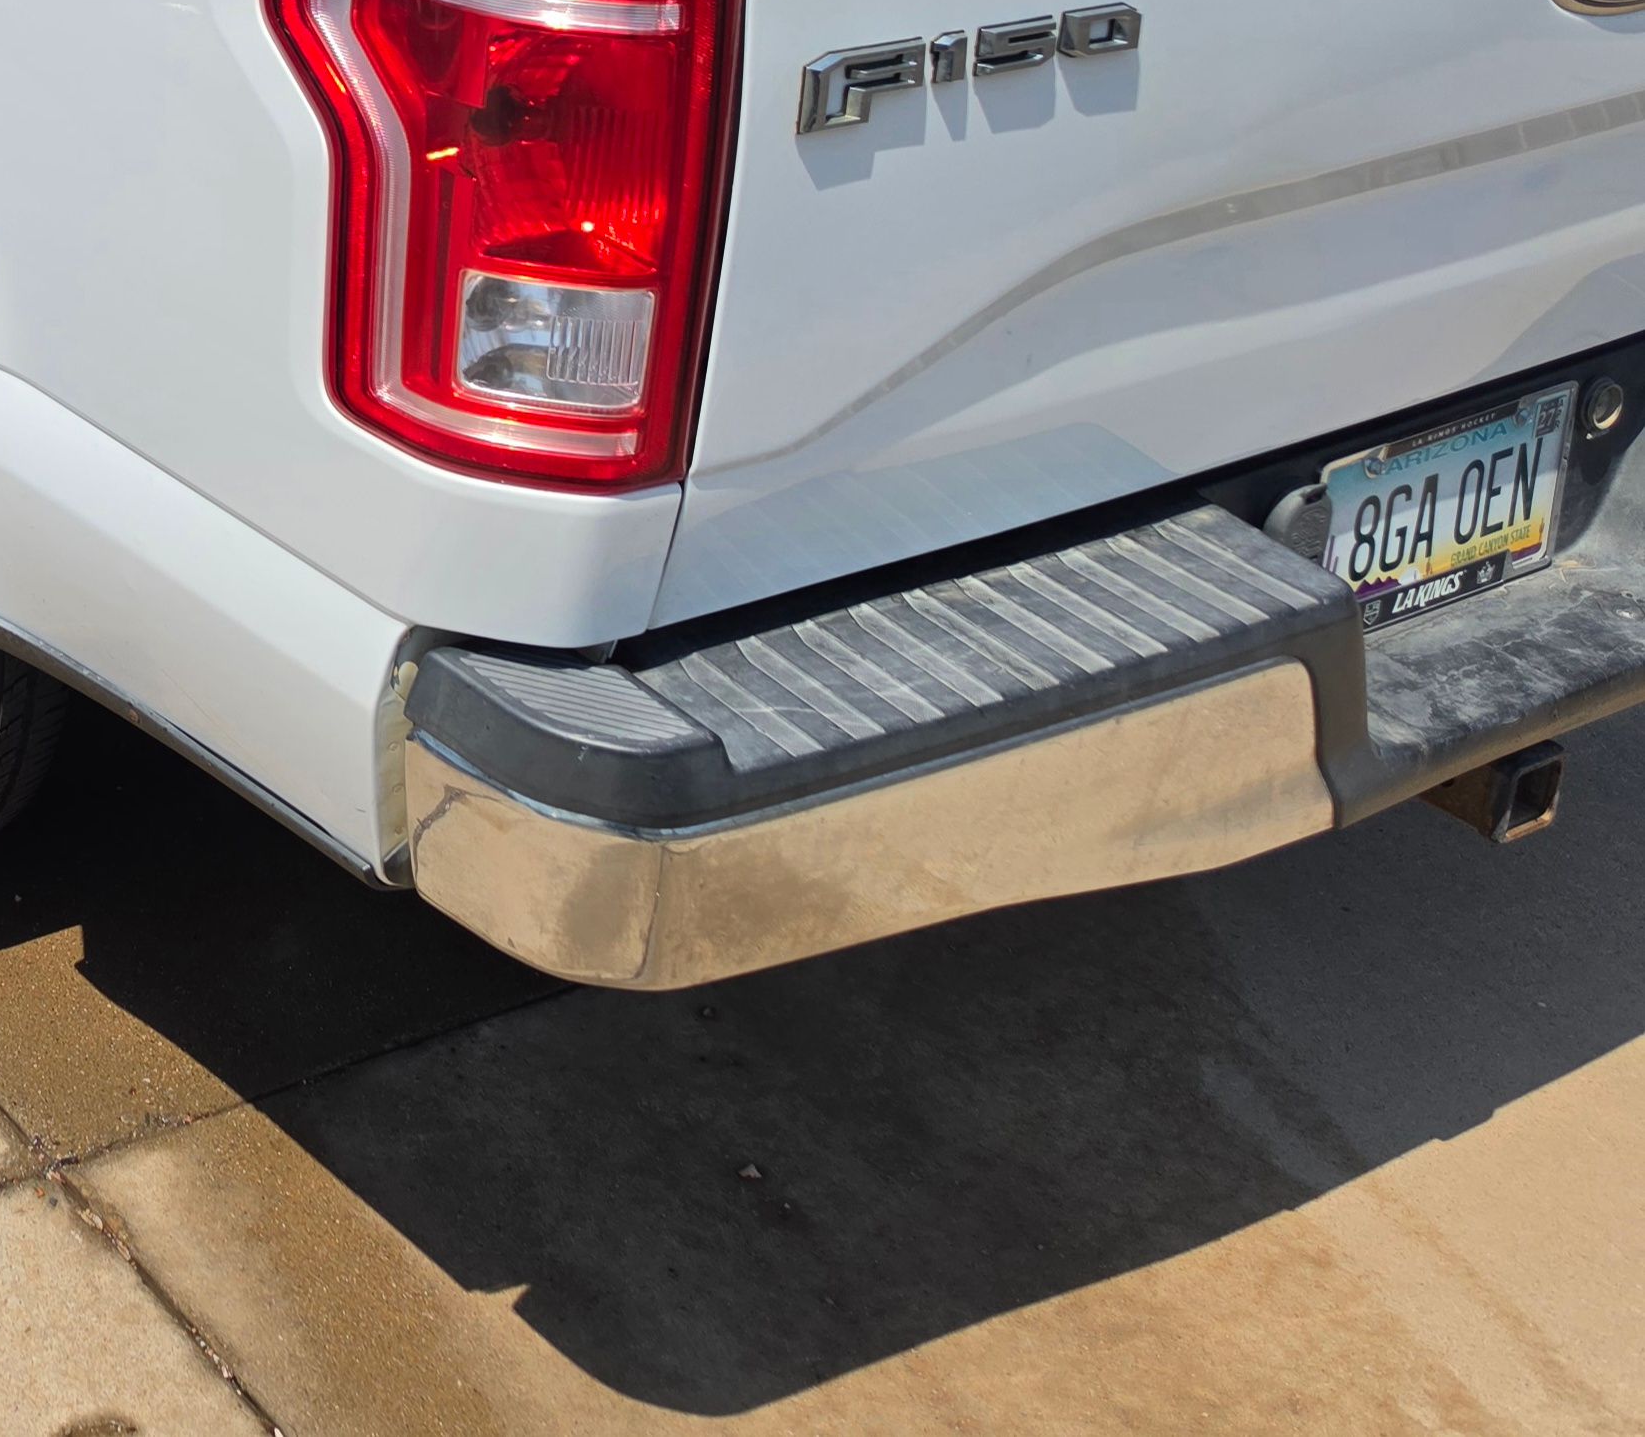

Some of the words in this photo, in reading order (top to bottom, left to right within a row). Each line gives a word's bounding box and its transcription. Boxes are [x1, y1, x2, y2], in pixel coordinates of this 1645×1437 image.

[1385, 422, 1508, 475] ARIZONA
[1349, 473, 1439, 582] 8GA
[1450, 546, 1477, 566] GRAND
[1479, 535, 1508, 556] CANYON
[1509, 525, 1532, 544] STATE
